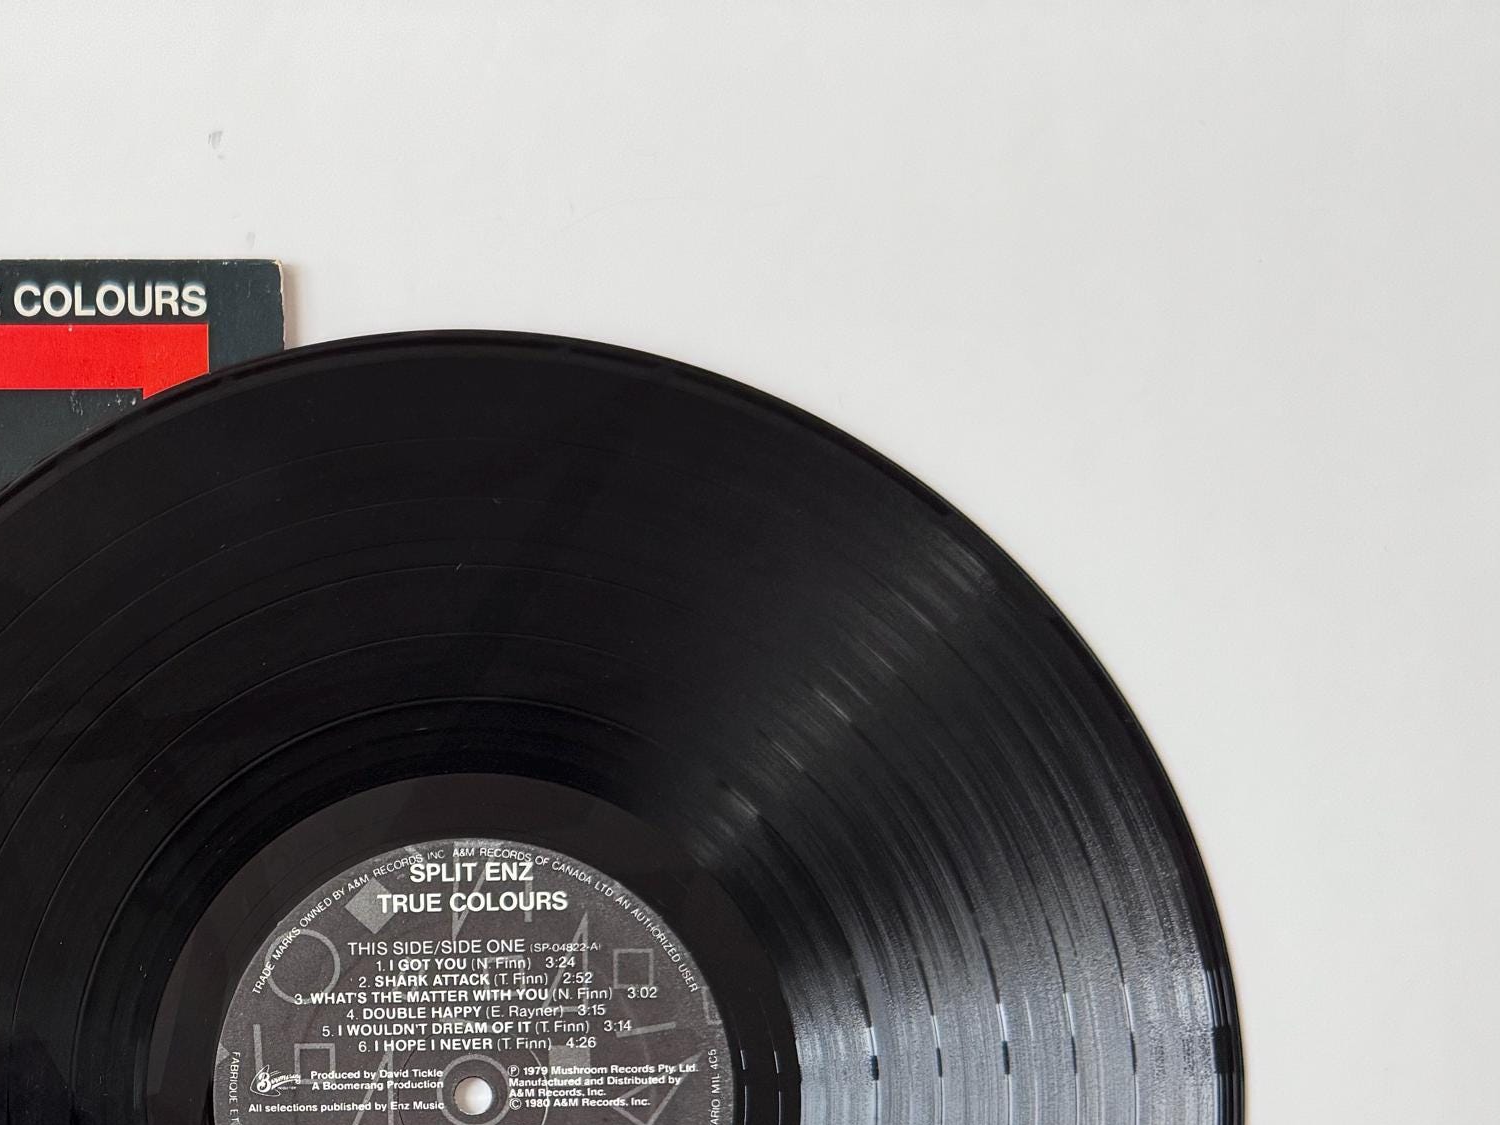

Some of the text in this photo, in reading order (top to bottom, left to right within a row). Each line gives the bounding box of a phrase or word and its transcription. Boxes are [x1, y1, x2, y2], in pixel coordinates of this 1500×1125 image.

[13, 281, 207, 317] COLOURS
[410, 862, 534, 882] SPLIT ENZ
[377, 891, 568, 914] TRUE COLOURS
[252, 848, 699, 995] TRADE MARKS OWNED BY A&M RECORDS A&M RECORDS OF CANADA LTD AN AUTHORIZED USER
[348, 939, 525, 955] THIS SIDE/SIDE ONE
[399, 956, 576, 971] GOT YOU (N. Finn) 3:24
[375, 972, 593, 987] SHARK ATTACK (T. Finn) 2:52
[310, 987, 658, 1004] WHAT'S THE MATTER WITH YOU (N. Finn) 3:02
[363, 1004, 606, 1020] DOUBLE HAPPY (E. Rayner) 3:15
[346, 1019, 632, 1036] WOULDN'T DREAM OF IT (T. Finn) 3:14
[384, 1036, 596, 1051] HOPE NEVER (T. Finn) 4:26
[311, 1068, 444, 1081] Produced by David Tickle
[523, 1066, 548, 1075] 1979
[551, 1065, 608, 1075] Mushroom
[610, 1064, 655, 1074] Records
[322, 1080, 444, 1092] Boomerang Production
[509, 1075, 681, 1087] Manufactured and Distributed by
[509, 1087, 606, 1097] A&M Inc.
[249, 1101, 445, 1113] All selections published by Enz Music
[525, 1097, 650, 1108] 1980 A&M Inc.
